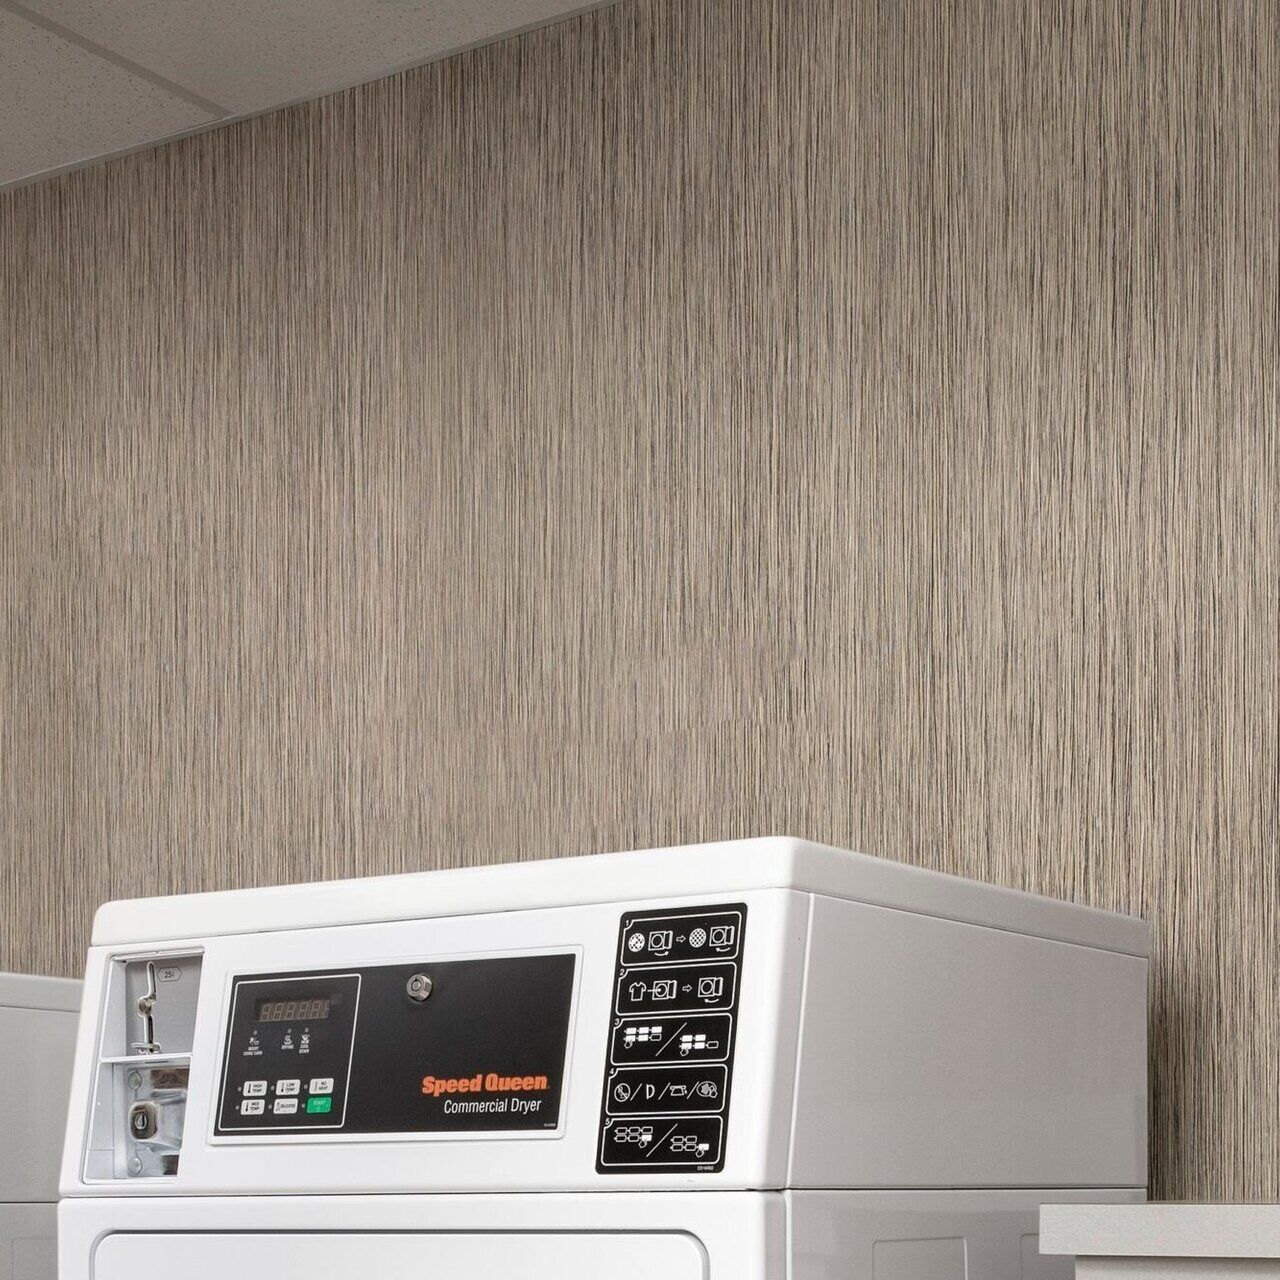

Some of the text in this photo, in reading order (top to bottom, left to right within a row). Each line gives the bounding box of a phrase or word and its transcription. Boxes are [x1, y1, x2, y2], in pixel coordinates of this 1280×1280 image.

[422, 1073, 548, 1097] Speed Queen
[443, 1098, 542, 1115] Commercial Dryer
